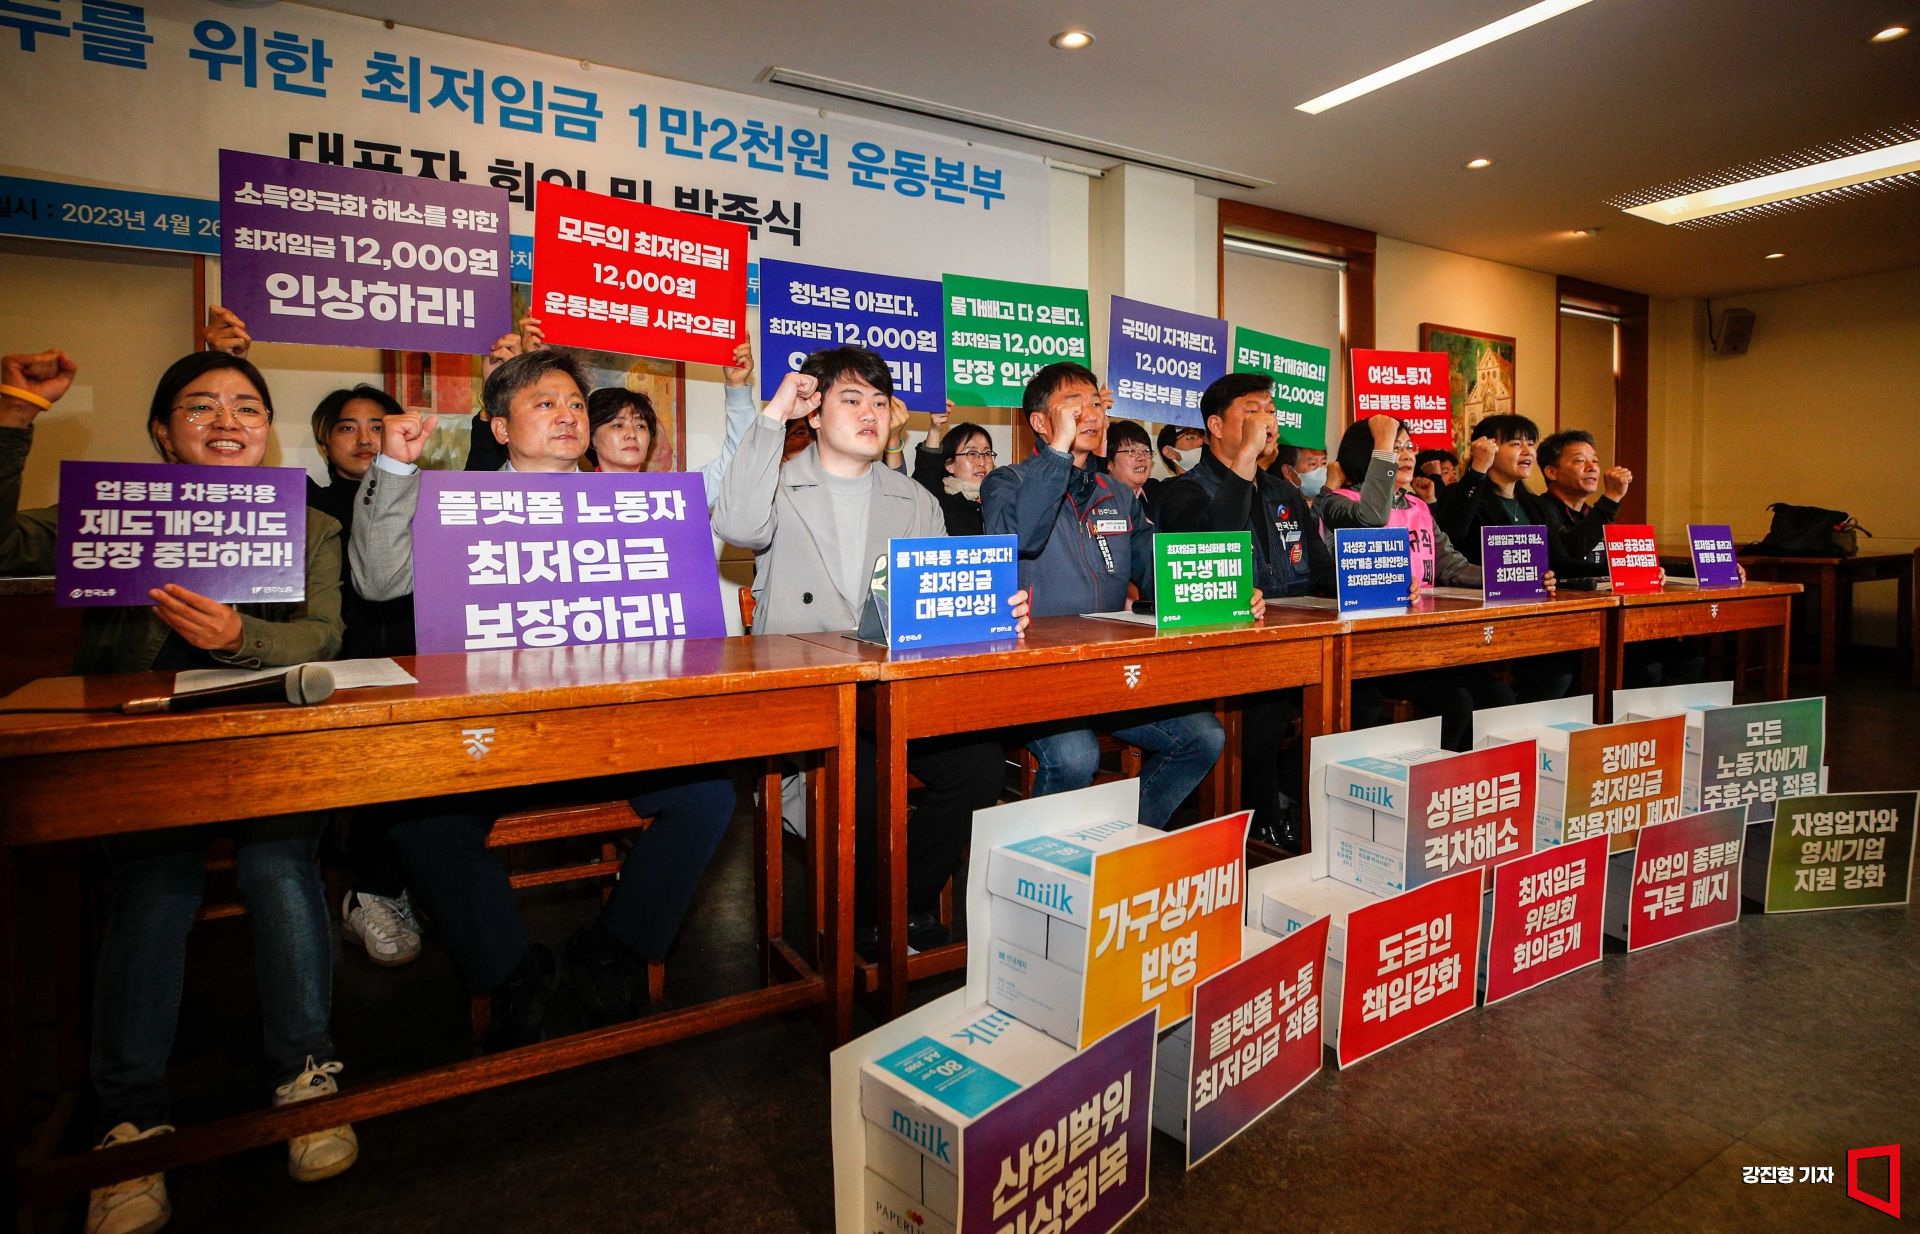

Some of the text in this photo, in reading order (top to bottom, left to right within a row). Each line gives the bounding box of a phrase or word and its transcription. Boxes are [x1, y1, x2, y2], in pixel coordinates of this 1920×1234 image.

[189, 20, 333, 98] 위한
[361, 50, 603, 142] 최저임금
[629, 104, 828, 180] 1만2천원
[848, 141, 1005, 210] 운동본부
[62, 203, 146, 231] 2023년
[153, 213, 191, 236] 4월
[234, 182, 499, 234] 소득양극화 해소를 위한
[234, 227, 499, 277] 최저임금 12,000원
[557, 215, 729, 271] 모두의 최저임금!
[592, 262, 696, 299] 12,000원
[789, 280, 919, 317] 청년은 아프다.
[265, 272, 475, 328] 인상하라!
[544, 291, 736, 340] 운동본부를 시작으로!
[951, 295, 1084, 327] 물가빼고 다 오른다.
[769, 317, 938, 353] 최저임금 12,000원
[951, 330, 1086, 358] 최저임금 12,000원
[1121, 318, 1161, 344] 국민이
[952, 358, 995, 385] 당장
[1135, 351, 1202, 381] 12,000원
[1237, 346, 1326, 382] 모두가 함께해요!!
[1368, 366, 1432, 385] 여성노동자
[1118, 379, 1182, 406] 운동본부를
[1277, 382, 1325, 407] 12,000원
[1358, 394, 1446, 410] 임금불평등 해소는
[95, 480, 276, 504] 업종별 차등적용
[438, 490, 686, 526] 플랫폼 노동자
[79, 509, 288, 536] 제도개악시도
[1487, 534, 1527, 546] 성별임금격차
[71, 541, 293, 570] 당장 중단하라!
[467, 537, 669, 585] 최저임금
[896, 547, 1013, 568] 물가폭등 못살겠다!
[1166, 542, 1241, 555] 최저임금 현실화를 위한
[1340, 558, 1372, 571] 취약계층
[1343, 540, 1404, 554] 저성장 고물가시기
[1502, 549, 1531, 565] 올려라
[919, 570, 993, 594] 최저임금
[1167, 558, 1242, 580] 가구생계비
[1496, 566, 1538, 583] 최저임금!
[915, 594, 997, 620] 대폭인상!
[1174, 581, 1237, 603] 반영하라!
[464, 592, 686, 650] 보장하라!
[1746, 719, 1782, 747] 모든
[1602, 739, 1657, 774] 장애인
[1716, 745, 1808, 780] 노동자에게
[1349, 783, 1394, 809] miilk
[1427, 771, 1521, 829] 성별임금
[1589, 769, 1663, 808] 최저임금
[1703, 771, 1817, 810] 주휴수당 적용
[1567, 796, 1680, 840] 적용제외 폐지
[1791, 808, 1899, 837] 자영업자와
[1425, 817, 1519, 873] 격차해소
[1636, 839, 1740, 886] 사업의 종류별
[1800, 837, 1886, 865] 영세기업
[1518, 858, 1586, 908] 최저임금
[1643, 870, 1729, 921] 구분 폐지
[1794, 864, 1886, 892] 지원 강화
[1016, 878, 1074, 915] miilk
[1095, 858, 1240, 959] 가구생계비
[1524, 893, 1577, 936] 위원회
[1377, 913, 1452, 977] 도급인
[1513, 921, 1582, 974] 회의공개
[1142, 930, 1198, 1003] 반영
[1362, 953, 1461, 1023] 책임강화
[1210, 960, 1314, 1060] 플랫폼 노동
[1194, 994, 1319, 1113] 최저임금 적용
[891, 1109, 951, 1164] miilk
[992, 1070, 1132, 1221] 산입범위
